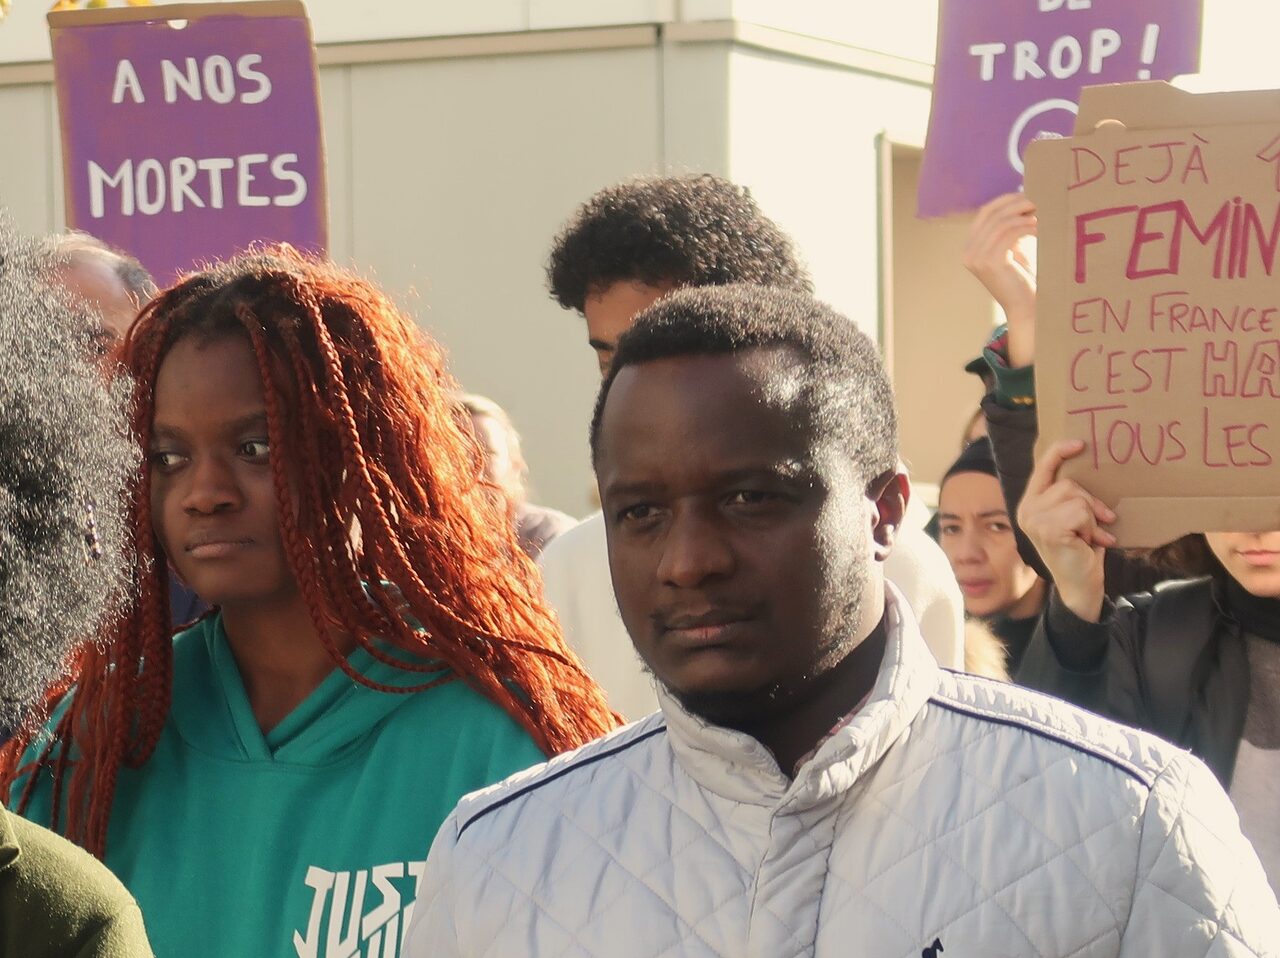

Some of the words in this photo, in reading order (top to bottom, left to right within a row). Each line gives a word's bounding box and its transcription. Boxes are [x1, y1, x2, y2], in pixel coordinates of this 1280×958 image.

[111, 59, 146, 104] A
[160, 53, 272, 104] NOS
[969, 28, 1122, 81] TROP
[87, 153, 308, 218] MORTES
[1072, 298, 1131, 335] EN
[1149, 291, 1278, 334] FRANCE
[1070, 344, 1188, 394] C'EST
[1067, 404, 1187, 470] TOUS
[1203, 406, 1272, 467] LES
